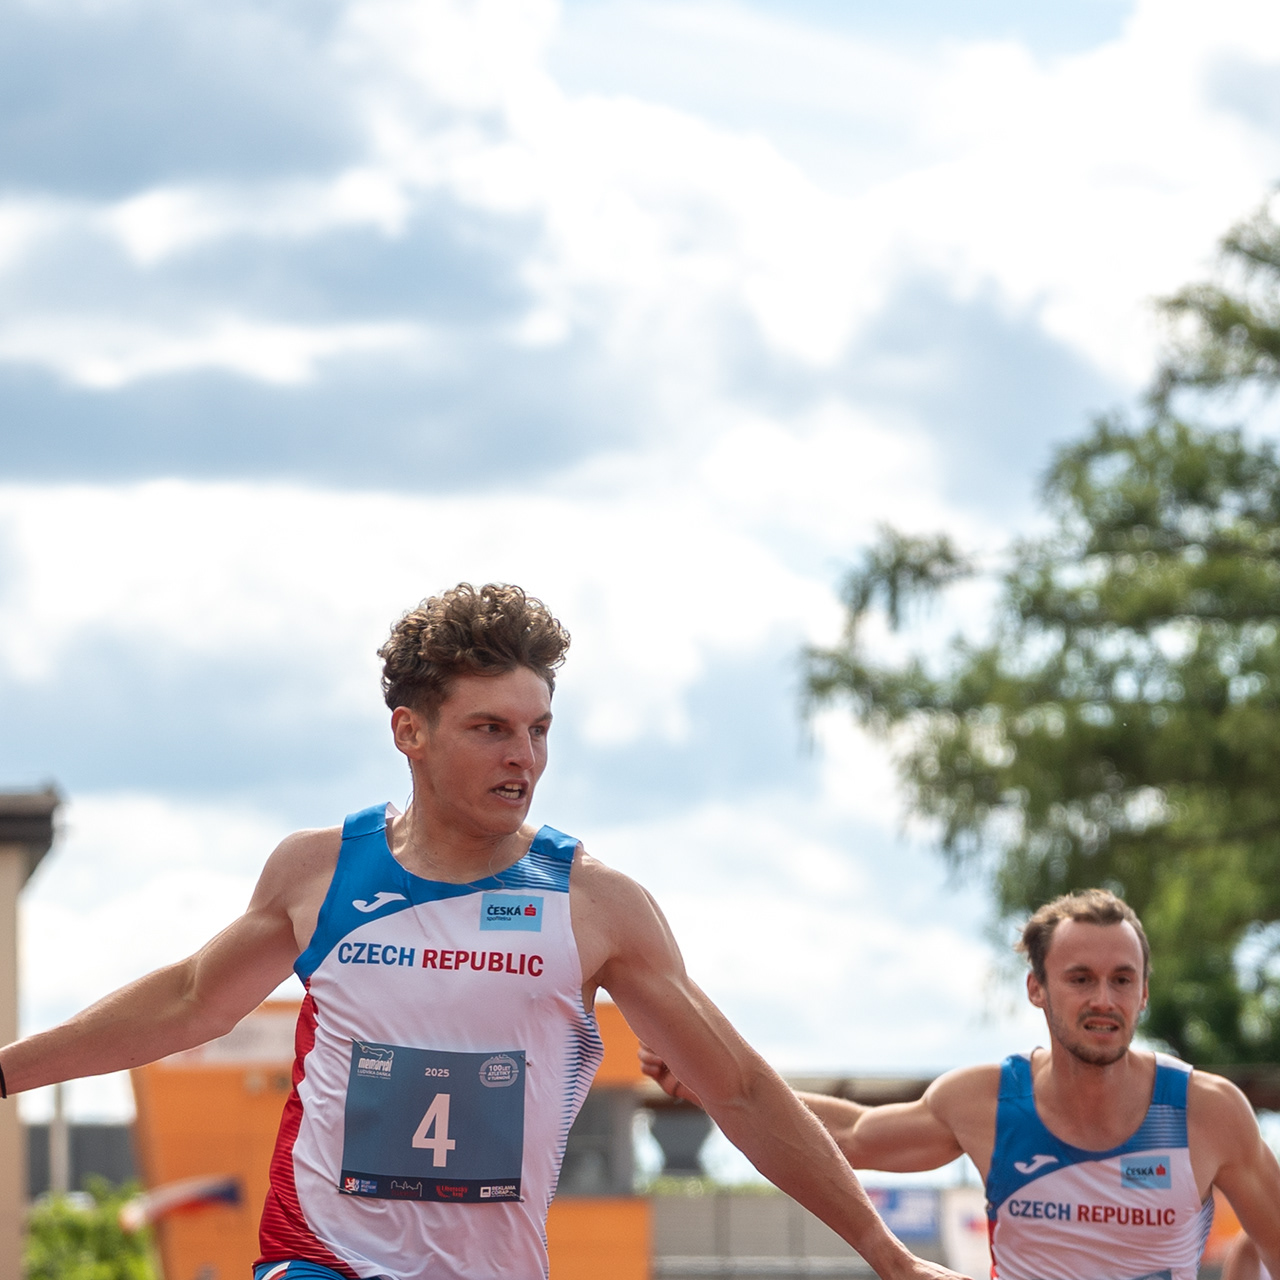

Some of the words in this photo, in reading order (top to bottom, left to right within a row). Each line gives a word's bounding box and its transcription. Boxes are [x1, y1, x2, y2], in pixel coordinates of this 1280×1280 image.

[486, 904, 521, 916] ČESKÁ
[338, 942, 415, 967] CZECH
[422, 949, 544, 977] REPUBLIC
[425, 1067, 450, 1078] 2025
[412, 1093, 456, 1168] 4
[1125, 1166, 1154, 1177] ČESKÁ
[1008, 1199, 1071, 1222] CZECH
[1077, 1204, 1176, 1227] REPUBLIC
